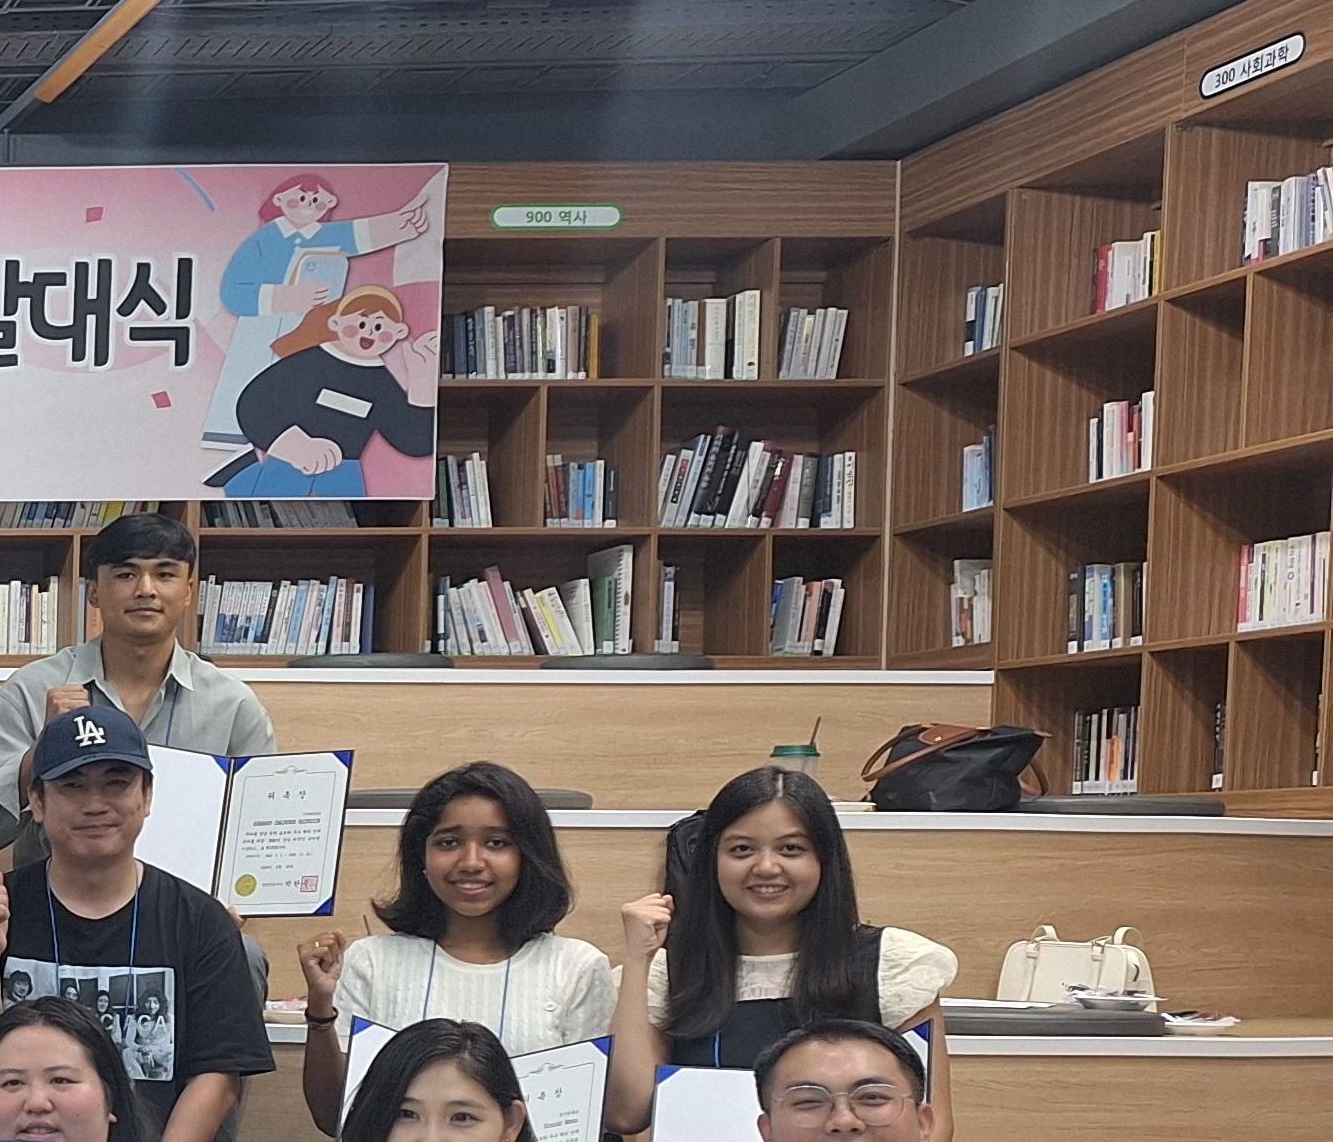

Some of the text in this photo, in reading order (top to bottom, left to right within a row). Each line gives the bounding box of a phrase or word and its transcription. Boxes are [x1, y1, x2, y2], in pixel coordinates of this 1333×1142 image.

[1215, 44, 1290, 88] 300 사회과학
[526, 210, 587, 224] 900 역사
[73, 715, 106, 747] LA
